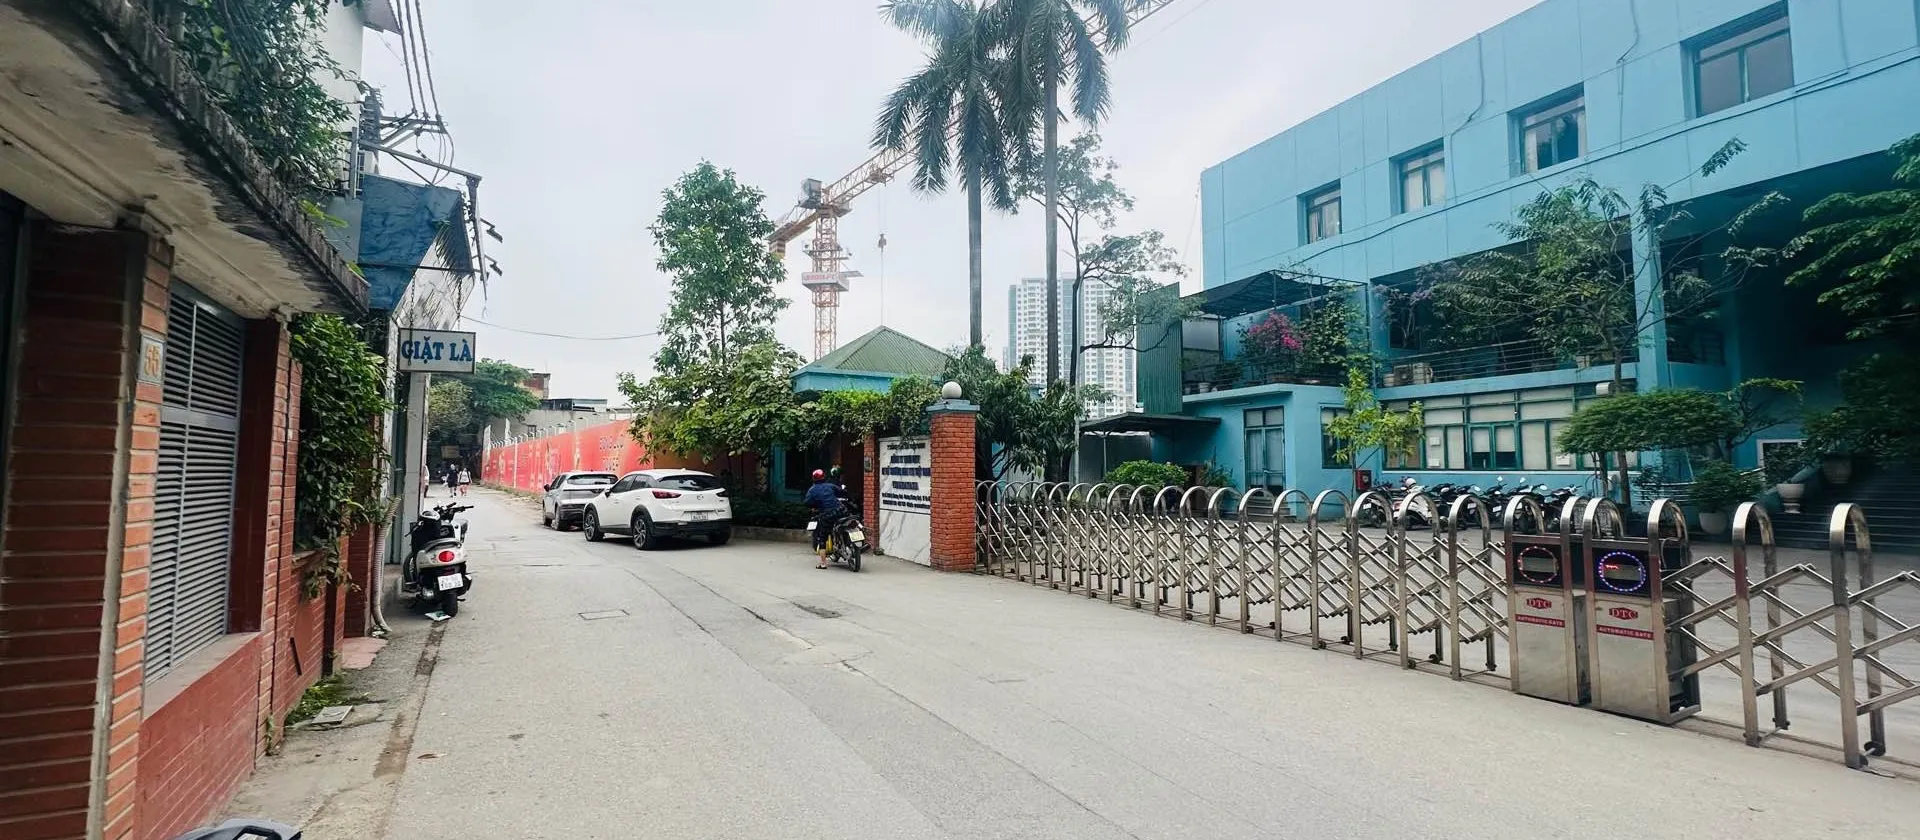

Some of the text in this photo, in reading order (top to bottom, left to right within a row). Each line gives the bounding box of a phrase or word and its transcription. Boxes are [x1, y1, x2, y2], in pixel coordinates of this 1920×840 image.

[401, 335, 473, 364] GIẶT LÀ
[1528, 599, 1550, 609] DTC
[1612, 608, 1637, 619] DTC
[1517, 615, 1548, 624] AUTOMATIC
[1599, 626, 1652, 638] AUTOMATIC GATE
